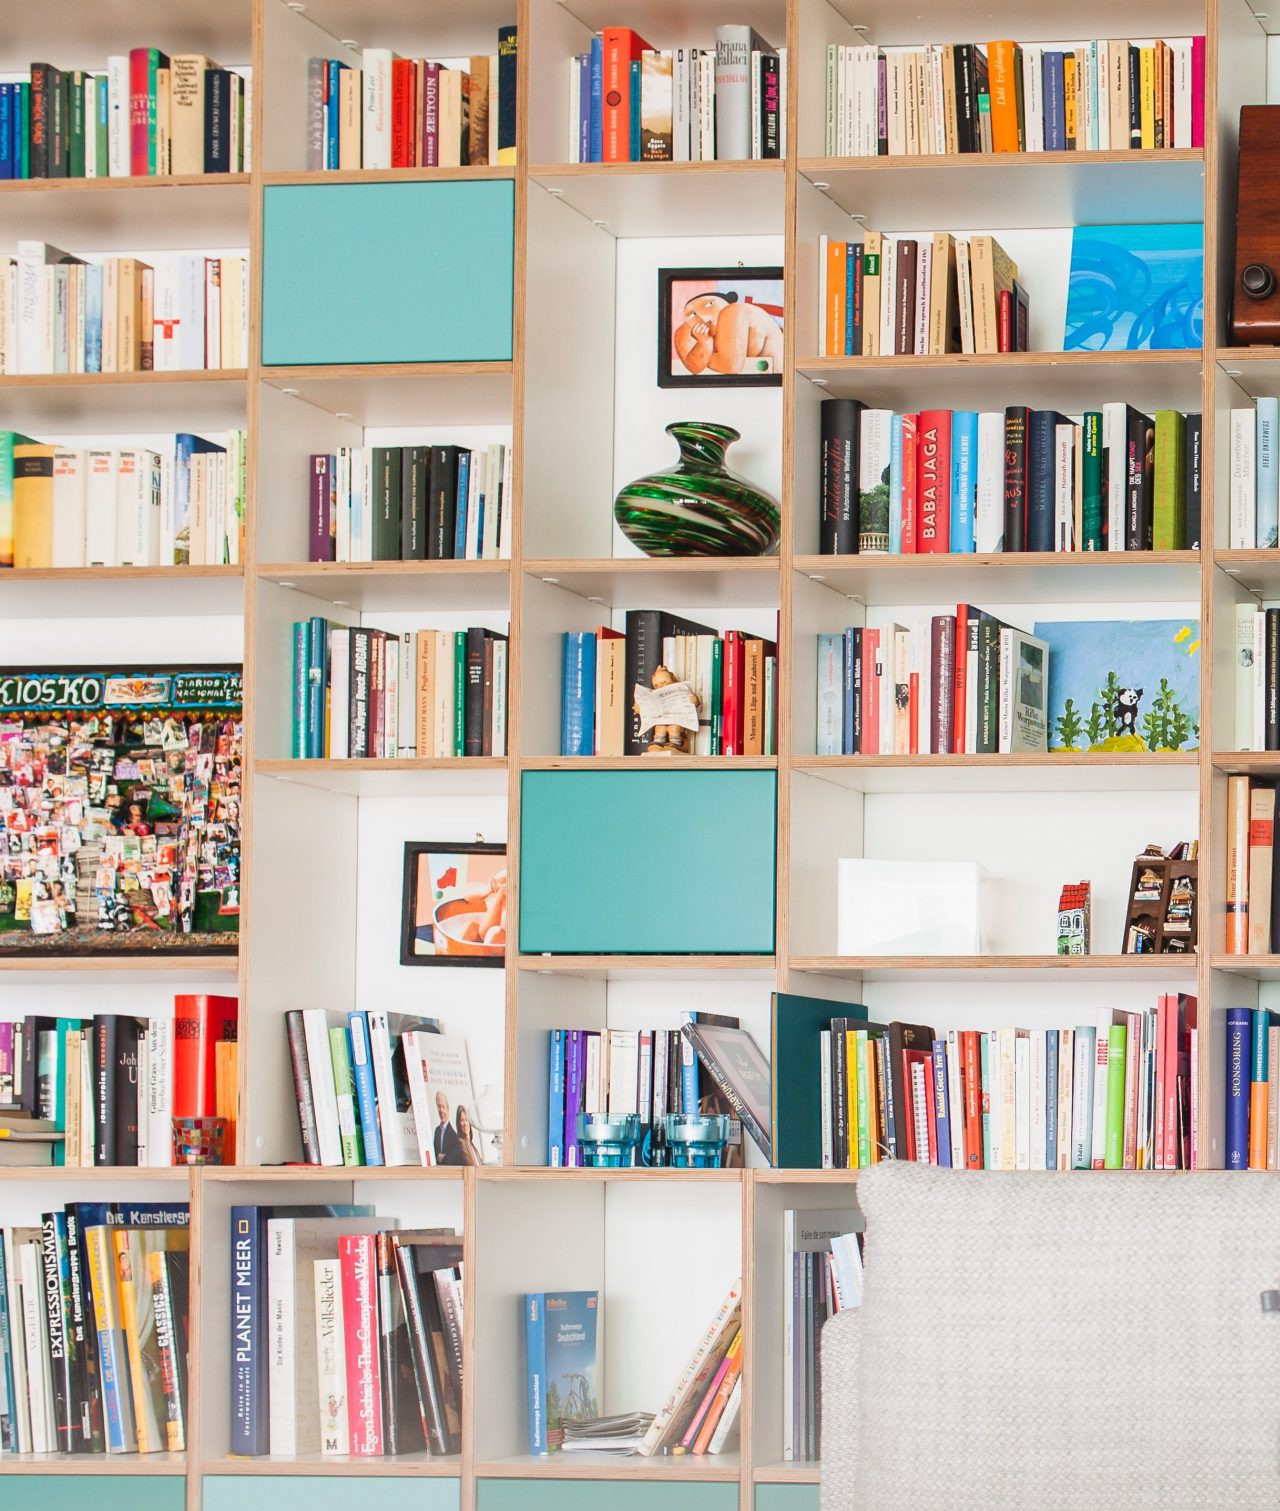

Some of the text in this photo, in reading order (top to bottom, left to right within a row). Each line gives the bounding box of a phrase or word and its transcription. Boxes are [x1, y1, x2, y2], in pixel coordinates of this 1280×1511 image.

[716, 40, 747, 52] Oriana
[717, 52, 747, 67] Fallaci
[426, 77, 436, 133] ZEITOUN
[593, 64, 602, 96] Ein Job
[312, 79, 323, 150] NABOKOV
[844, 440, 852, 521] 99 Autorinnen der Weltliteratur
[1060, 441, 1068, 468] Arendt
[923, 428, 937, 539] BABA JAGA
[356, 633, 368, 672] ABGANG
[1097, 1039, 1109, 1066] IRRE!
[1231, 1033, 1243, 1097] SPONSORING
[41, 1220, 64, 1359] EXPRESSIONISMUS
[237, 1239, 252, 1362] PLANET MEER
[321, 1268, 336, 1337] Volkslieder
[153, 1293, 170, 1347] CLASSICS
[357, 1344, 372, 1368] The
[361, 1420, 378, 1453] Egon
